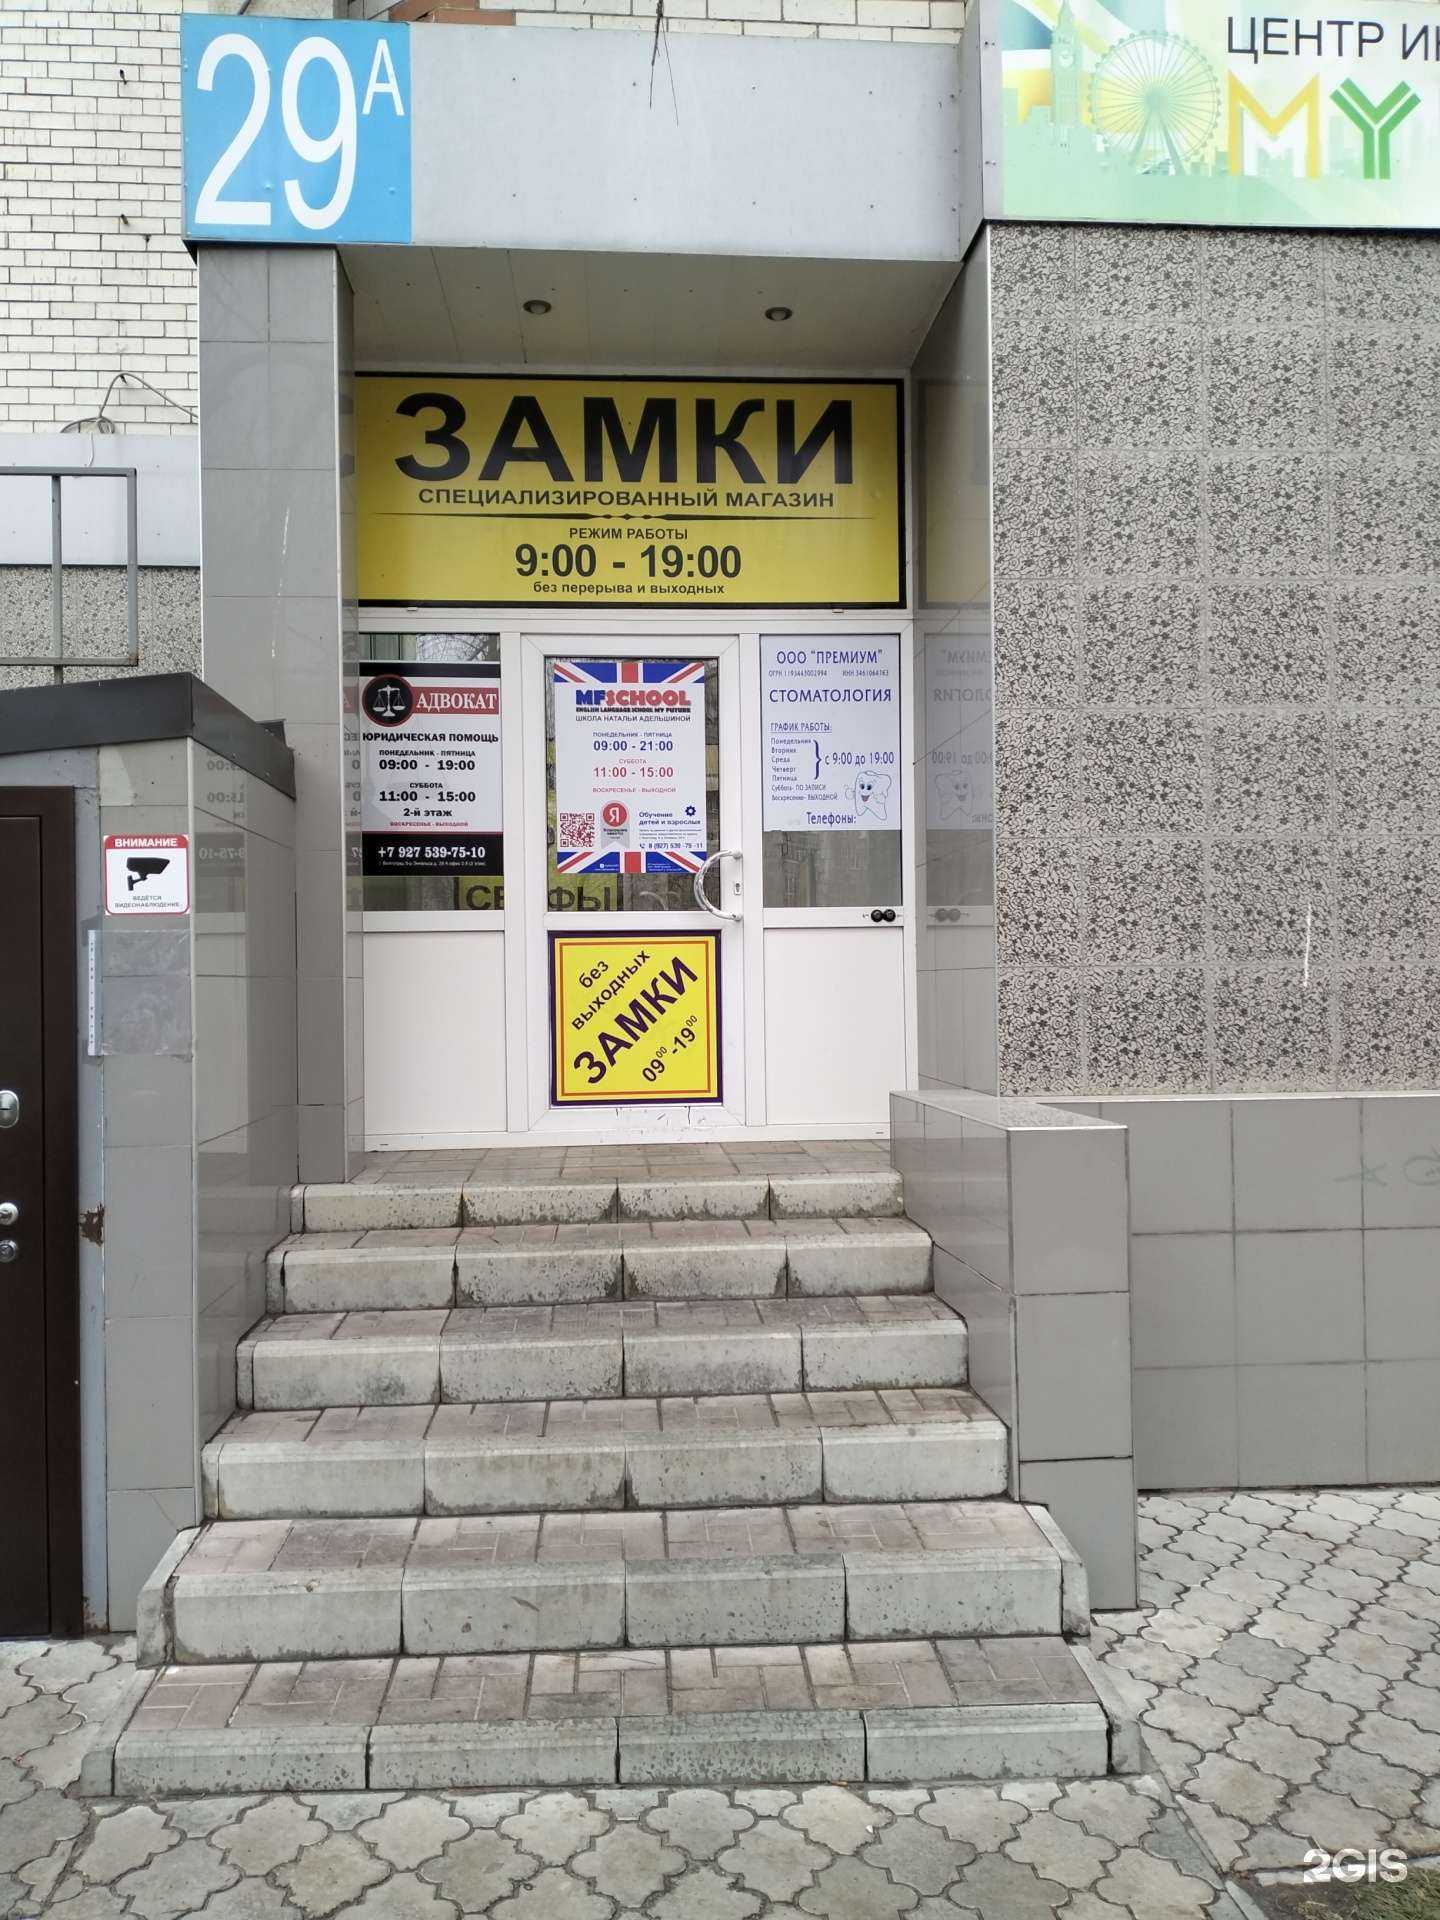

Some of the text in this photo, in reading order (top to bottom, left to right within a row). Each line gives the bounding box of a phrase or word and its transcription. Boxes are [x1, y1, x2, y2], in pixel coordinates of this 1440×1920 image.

[1227, 17, 1440, 64] ЦЕНТР И
[1228, 70, 1421, 180] MY
[395, 391, 853, 485] ЗАМКИ
[418, 489, 834, 508] СПЕЦИАЛИЗИРОВАННЫЙ МАГАЗИН
[569, 528, 688, 540] РЕЖИМ РАБОТЫ
[514, 543, 597, 577] 9:00
[640, 544, 742, 578] 19:00
[533, 582, 725, 595] без перерыва и выходных
[776, 651, 807, 664] ООО
[416, 693, 498, 712] АДВОКАТ
[576, 690, 692, 706] MFSCHOOL
[769, 689, 892, 703] СТОМАТОЛОГИЯ
[771, 722, 798, 731] ГРАФИК
[363, 733, 446, 743] ЮРИДИЧЕСКАЯ
[448, 733, 499, 743] ПОМОЩЬ
[593, 740, 628, 751] 09:00
[640, 740, 673, 751] 21:00
[379, 760, 418, 770] 09:00
[437, 760, 475, 770] 19:00
[832, 752, 853, 765] 9:00
[855, 756, 866, 766] до
[870, 752, 895, 764] 19:00
[593, 767, 627, 777] 11:00
[640, 766, 674, 777] 15:00
[379, 791, 418, 802] 11:00
[437, 791, 476, 801] 15:00
[403, 808, 420, 817] 2-й
[609, 807, 620, 823] Я
[806, 812, 857, 827] Телефоны:
[114, 838, 178, 847] ВНИМАНИЕ
[378, 847, 486, 858] +7 927 539-75-10
[578, 960, 609, 988] без
[571, 950, 650, 1030] выходных
[573, 956, 698, 1084] ЗАМКИ
